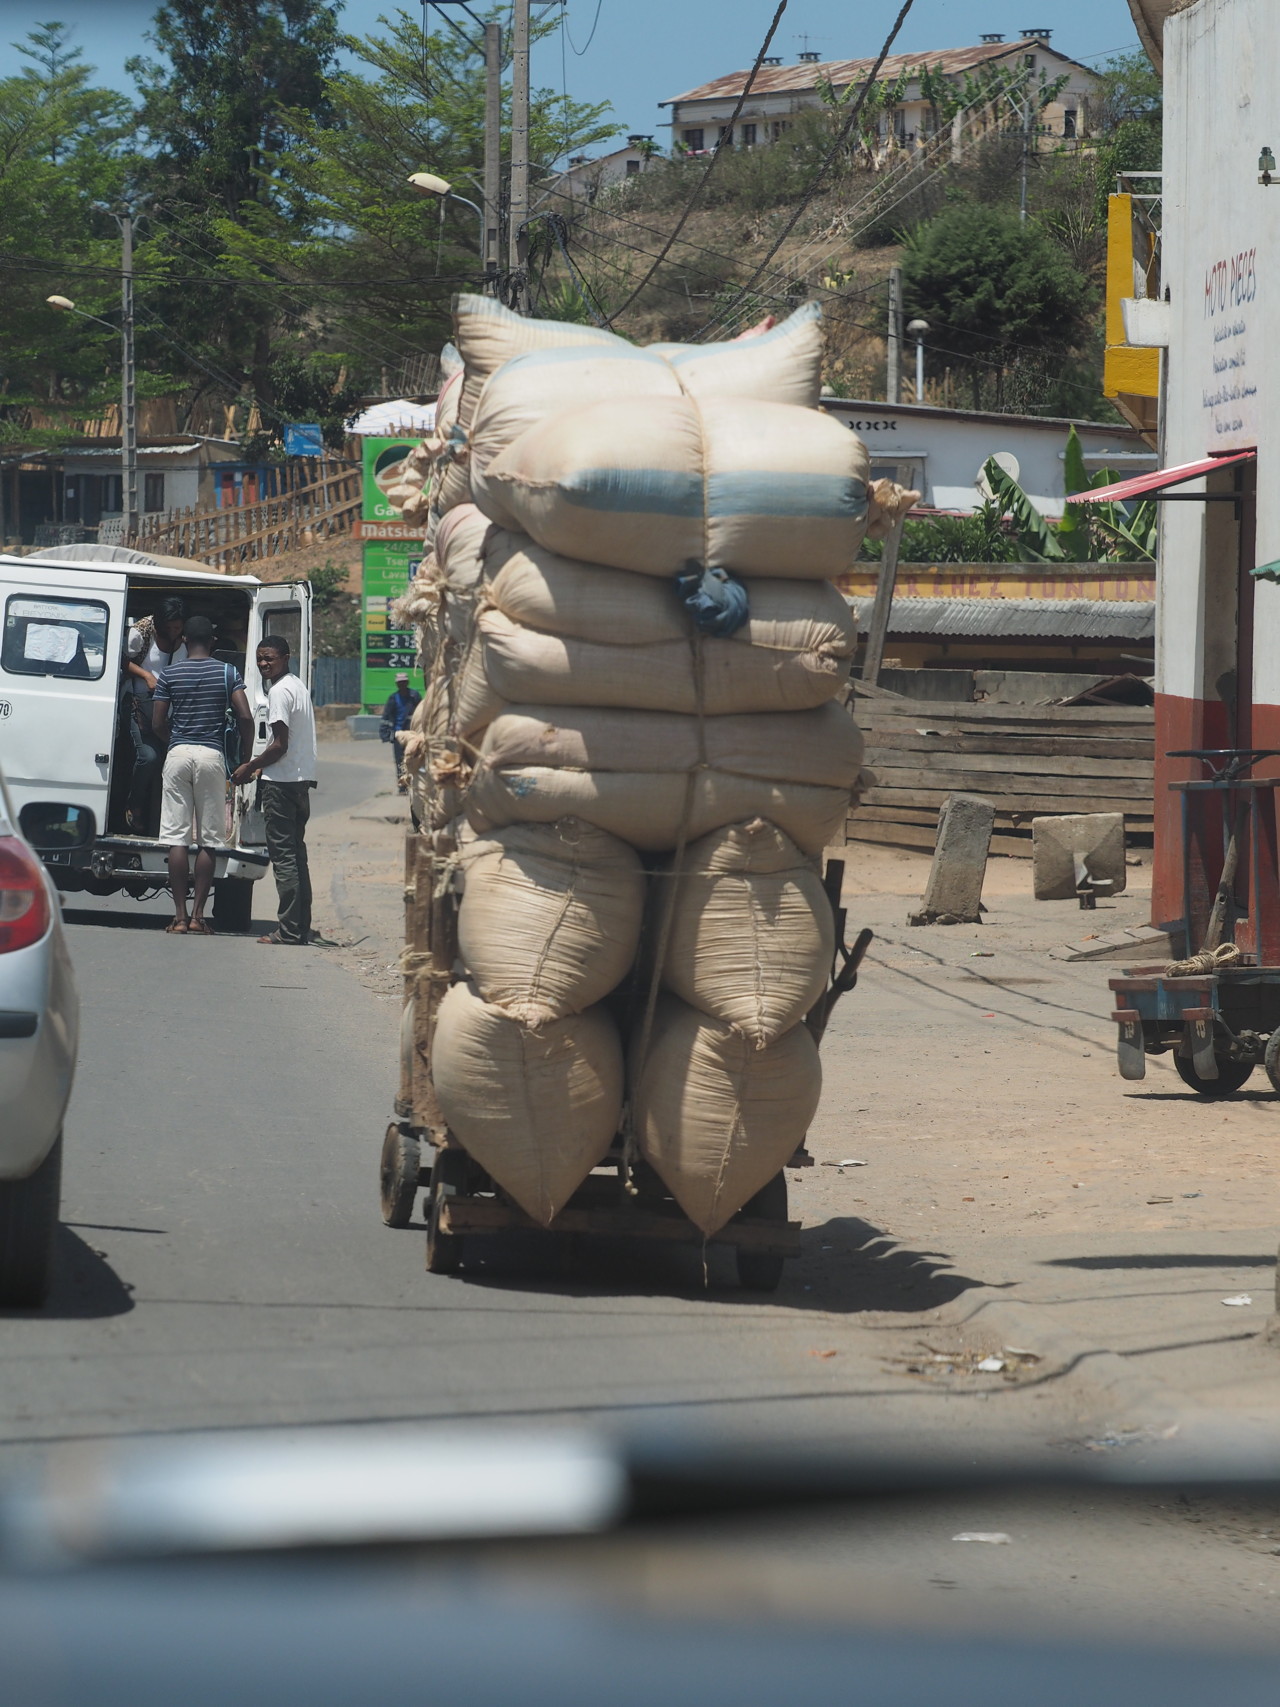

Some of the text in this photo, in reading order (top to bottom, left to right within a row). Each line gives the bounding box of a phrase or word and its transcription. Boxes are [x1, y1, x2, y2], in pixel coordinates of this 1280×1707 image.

[1204, 247, 1256, 320] MOTO PIECES
[383, 542, 418, 552] 24/24
[932, 574, 1002, 598] CHEZ
[1017, 574, 1156, 600] TONTON
